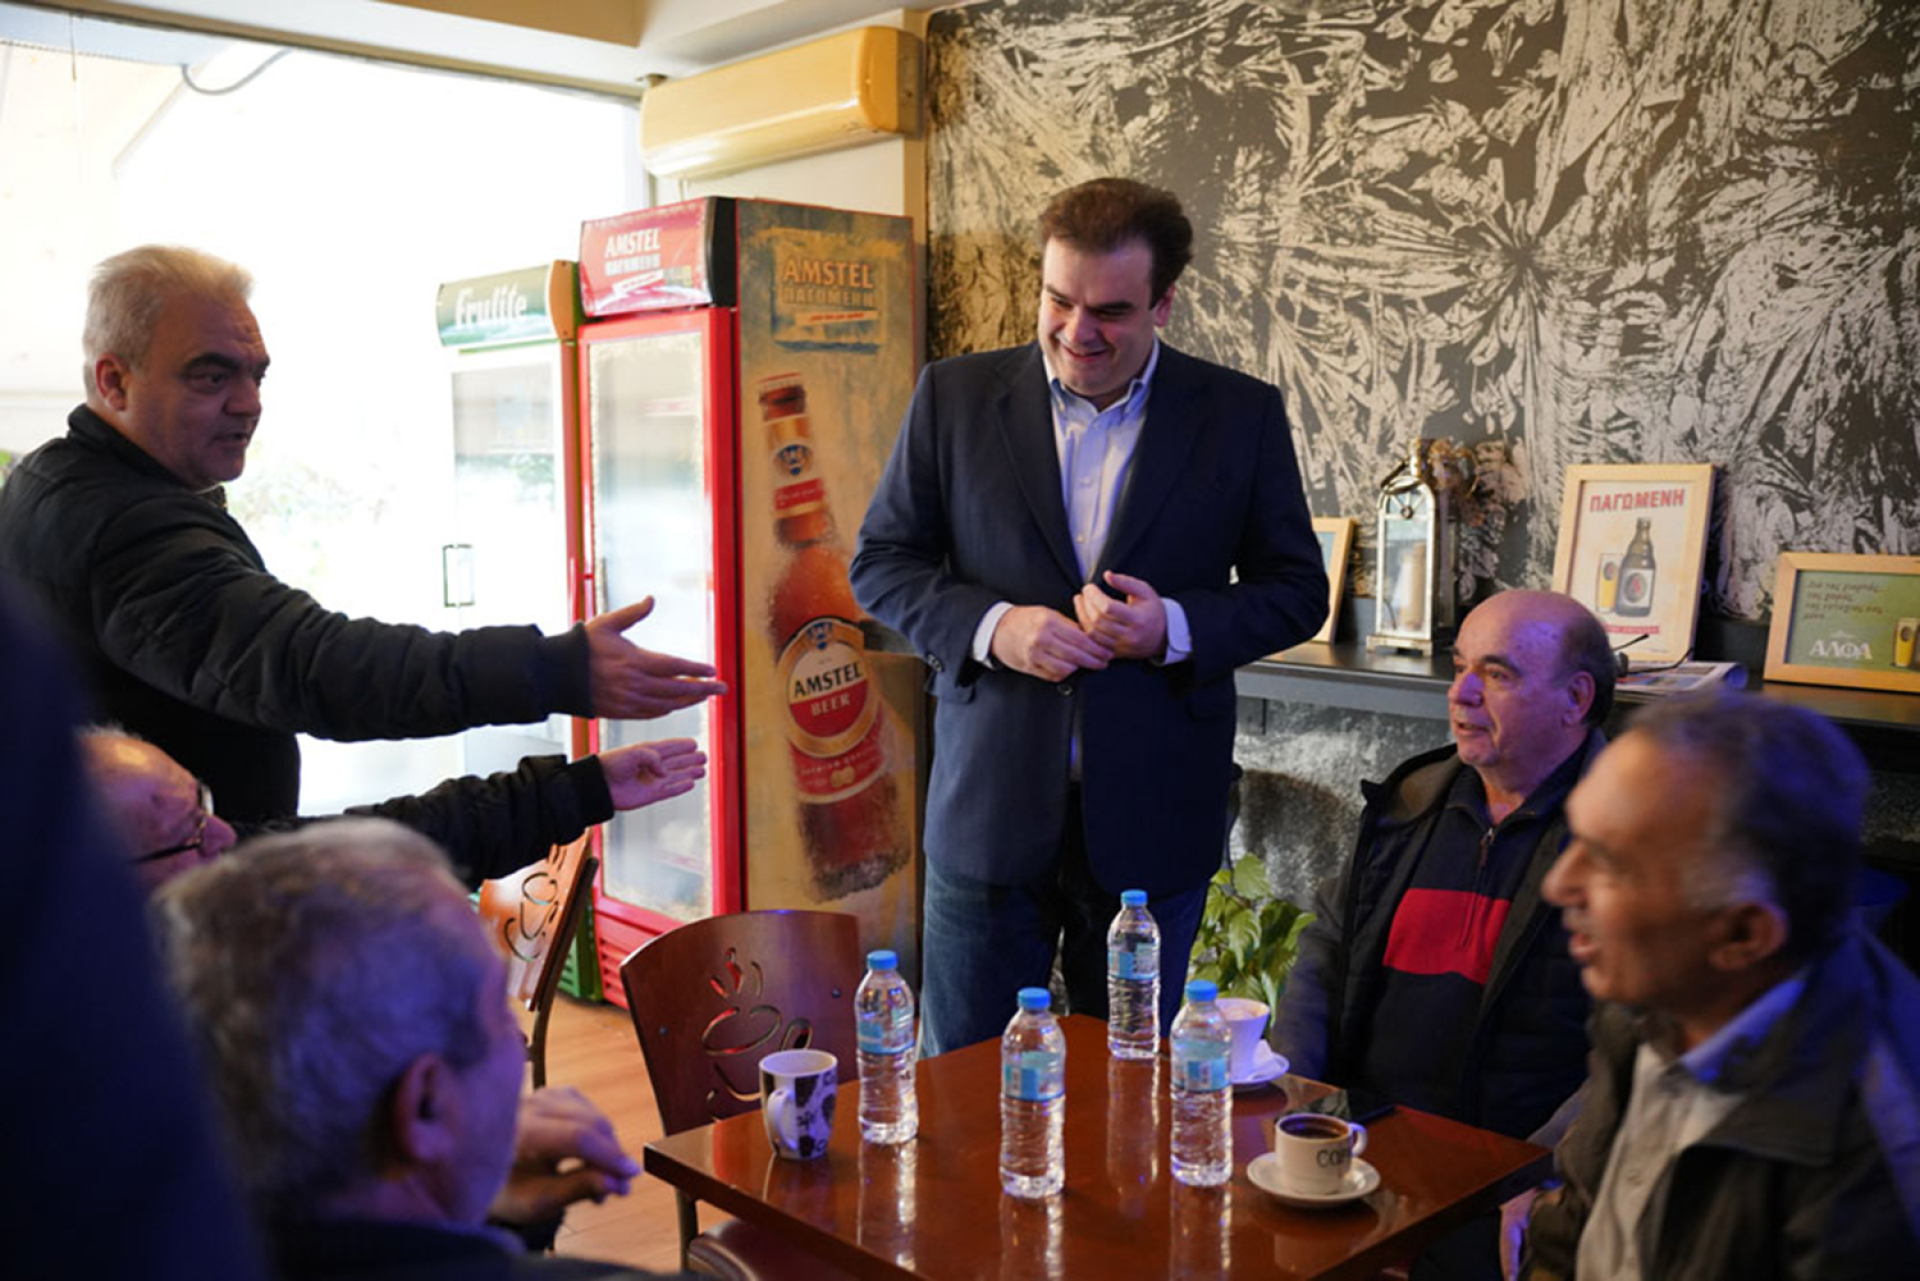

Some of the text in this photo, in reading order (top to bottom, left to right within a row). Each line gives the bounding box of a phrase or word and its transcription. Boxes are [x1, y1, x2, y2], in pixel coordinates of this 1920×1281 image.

[604, 228, 661, 259] AMSTEL
[783, 259, 874, 289] AMSTEL
[455, 283, 527, 328] Frulite
[1589, 488, 1685, 513] ΠΑΓΩΜΕΝΗ
[794, 663, 862, 697] AMSTEL
[811, 694, 850, 716] BEER
